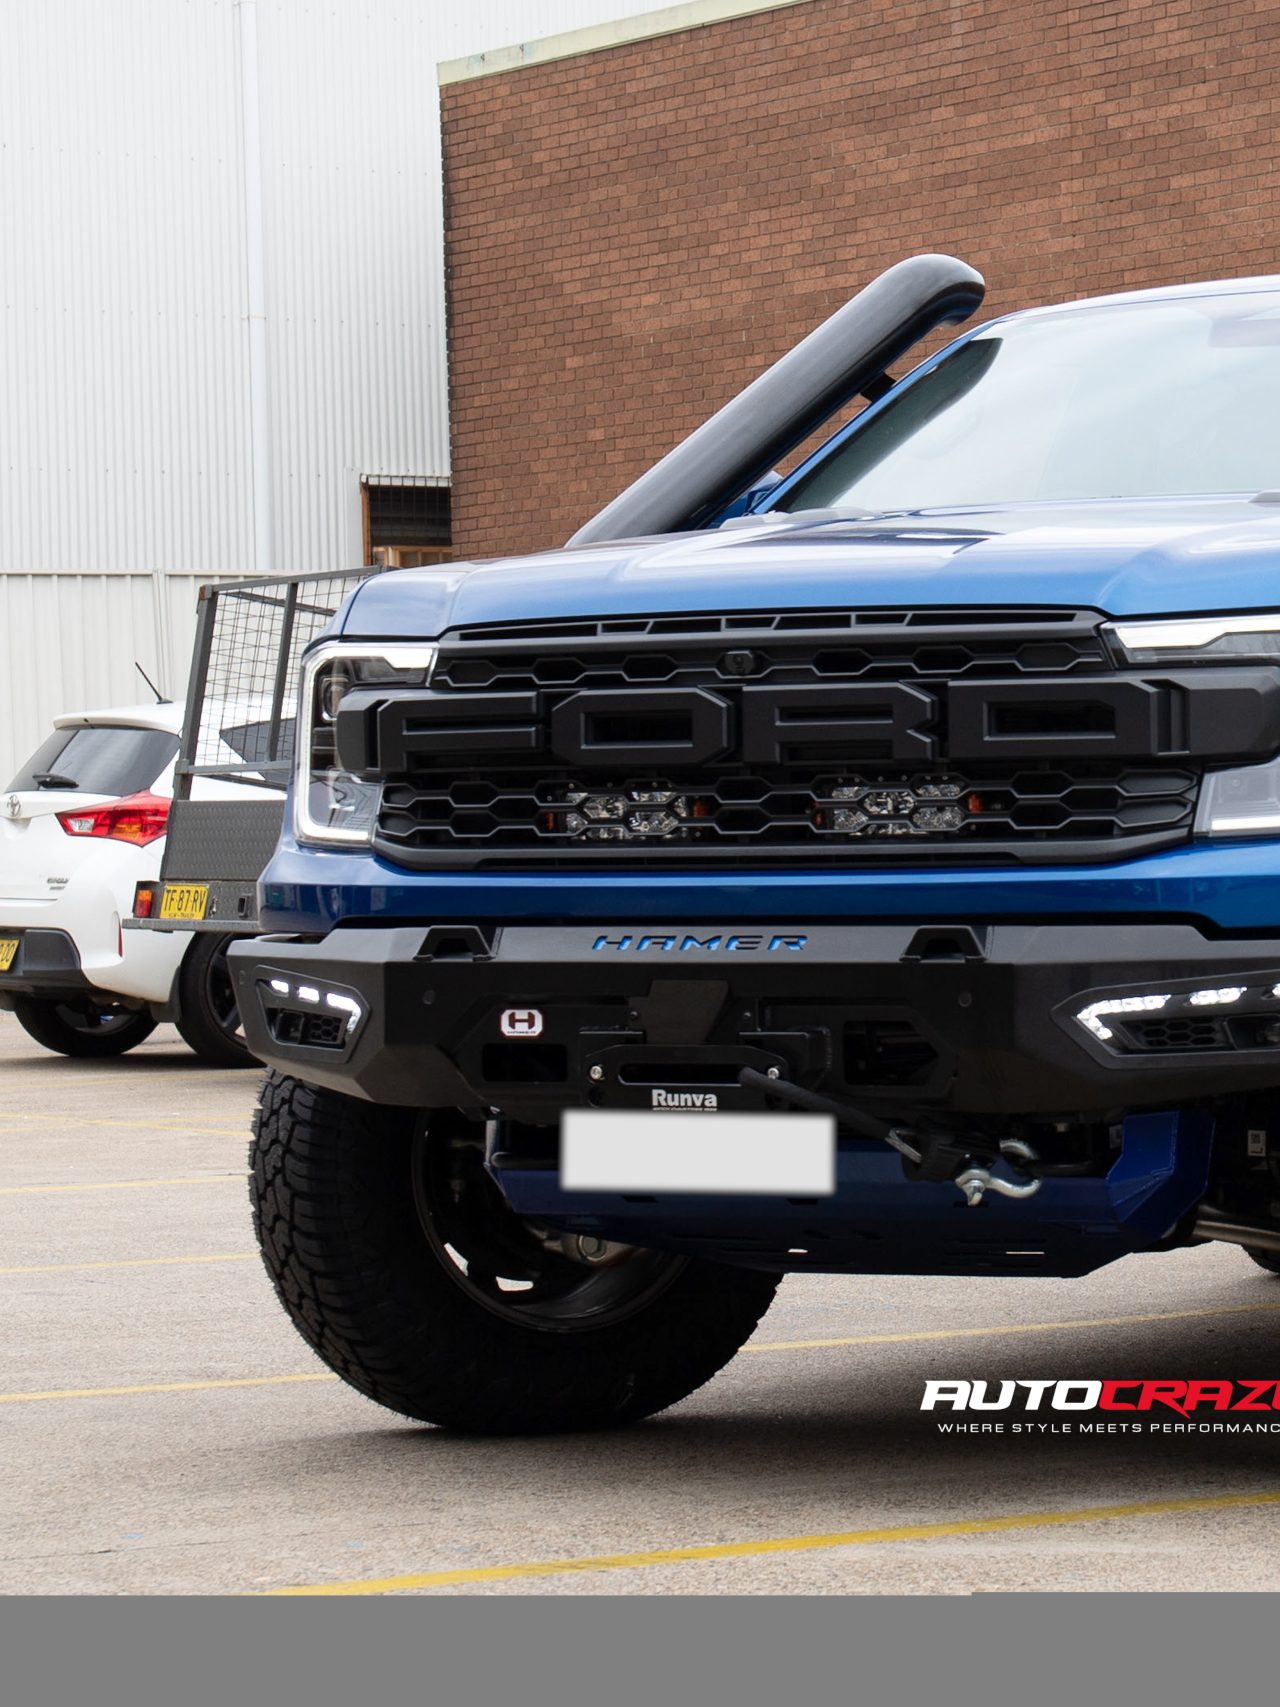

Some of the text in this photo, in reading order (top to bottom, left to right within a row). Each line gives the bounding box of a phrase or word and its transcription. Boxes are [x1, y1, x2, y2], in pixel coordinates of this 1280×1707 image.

[376, 679, 1158, 773] FORD
[592, 935, 808, 951] HAMER
[651, 1088, 718, 1107] Runva
